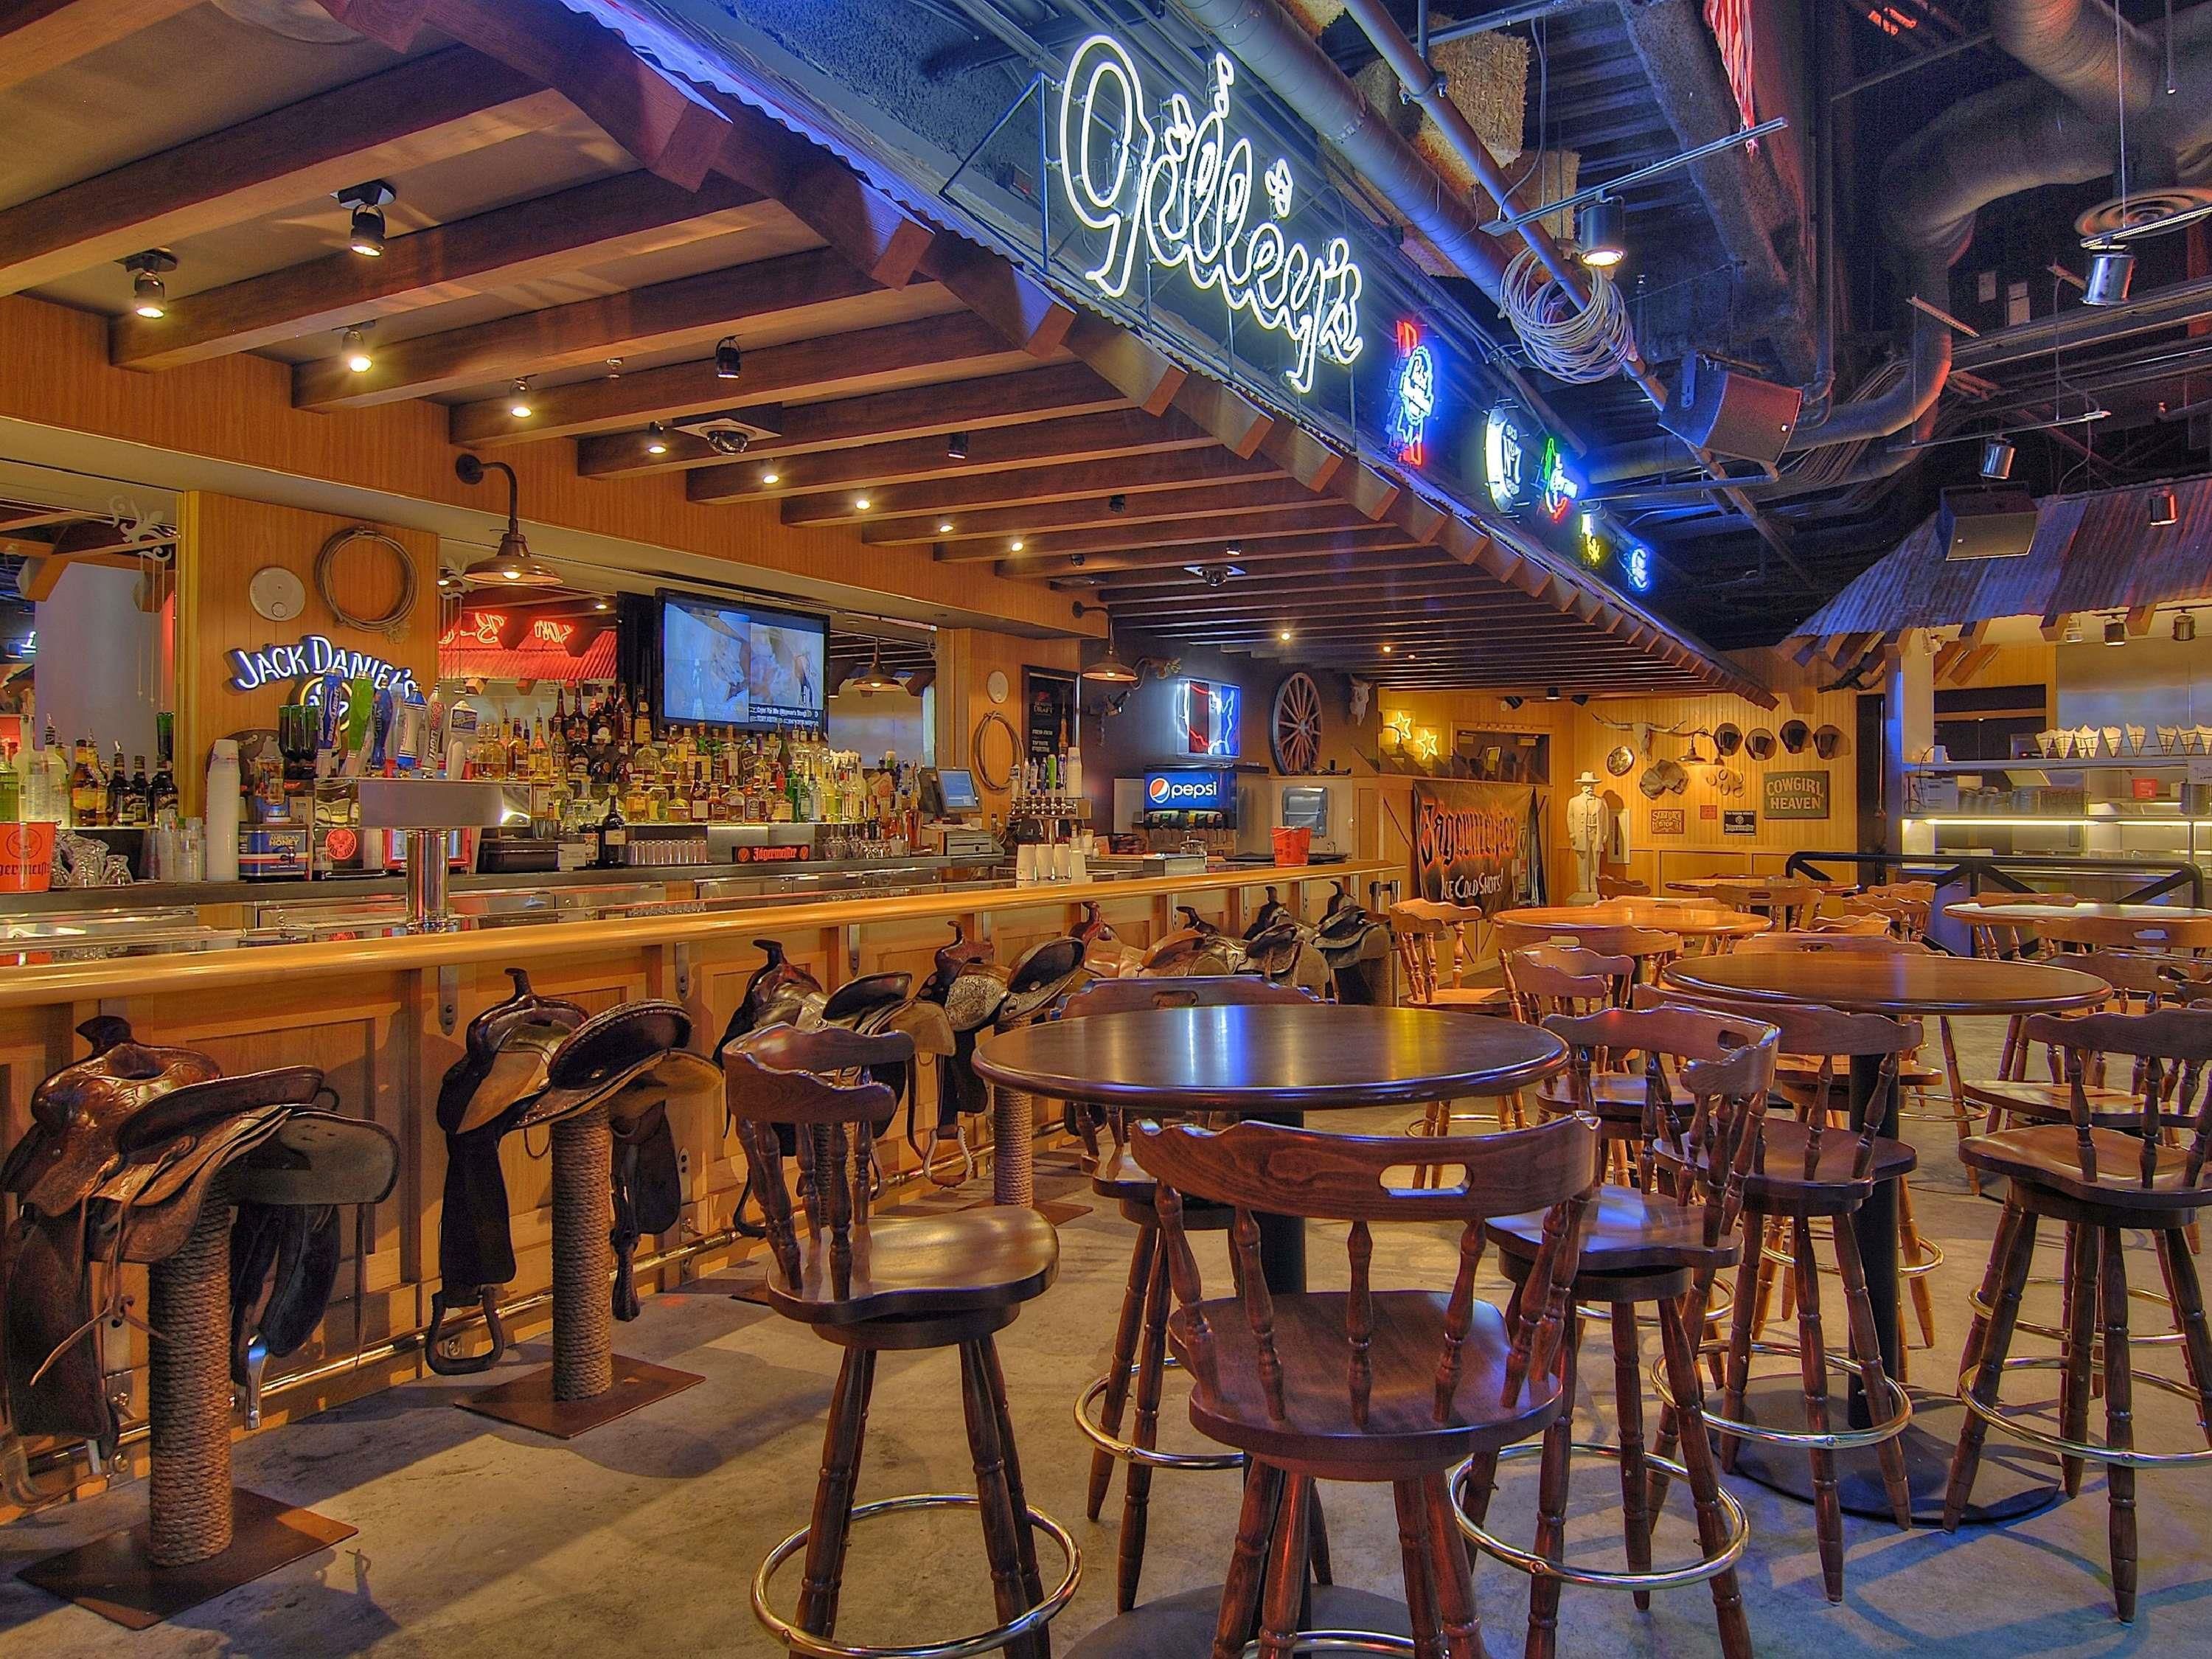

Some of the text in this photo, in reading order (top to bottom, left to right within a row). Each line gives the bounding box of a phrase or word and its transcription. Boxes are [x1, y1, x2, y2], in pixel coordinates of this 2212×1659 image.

[1060, 35, 1363, 394] Gilley's
[237, 644, 310, 690] JACK
[428, 728, 438, 762] LIGHT
[1171, 781, 1217, 799] pepsi
[1766, 776, 1824, 798] COWGIRL
[1770, 796, 1821, 810] HEAVEN
[269, 838, 299, 846] HONEY
[1441, 867, 1503, 901] ICE COLD SHOTS!
